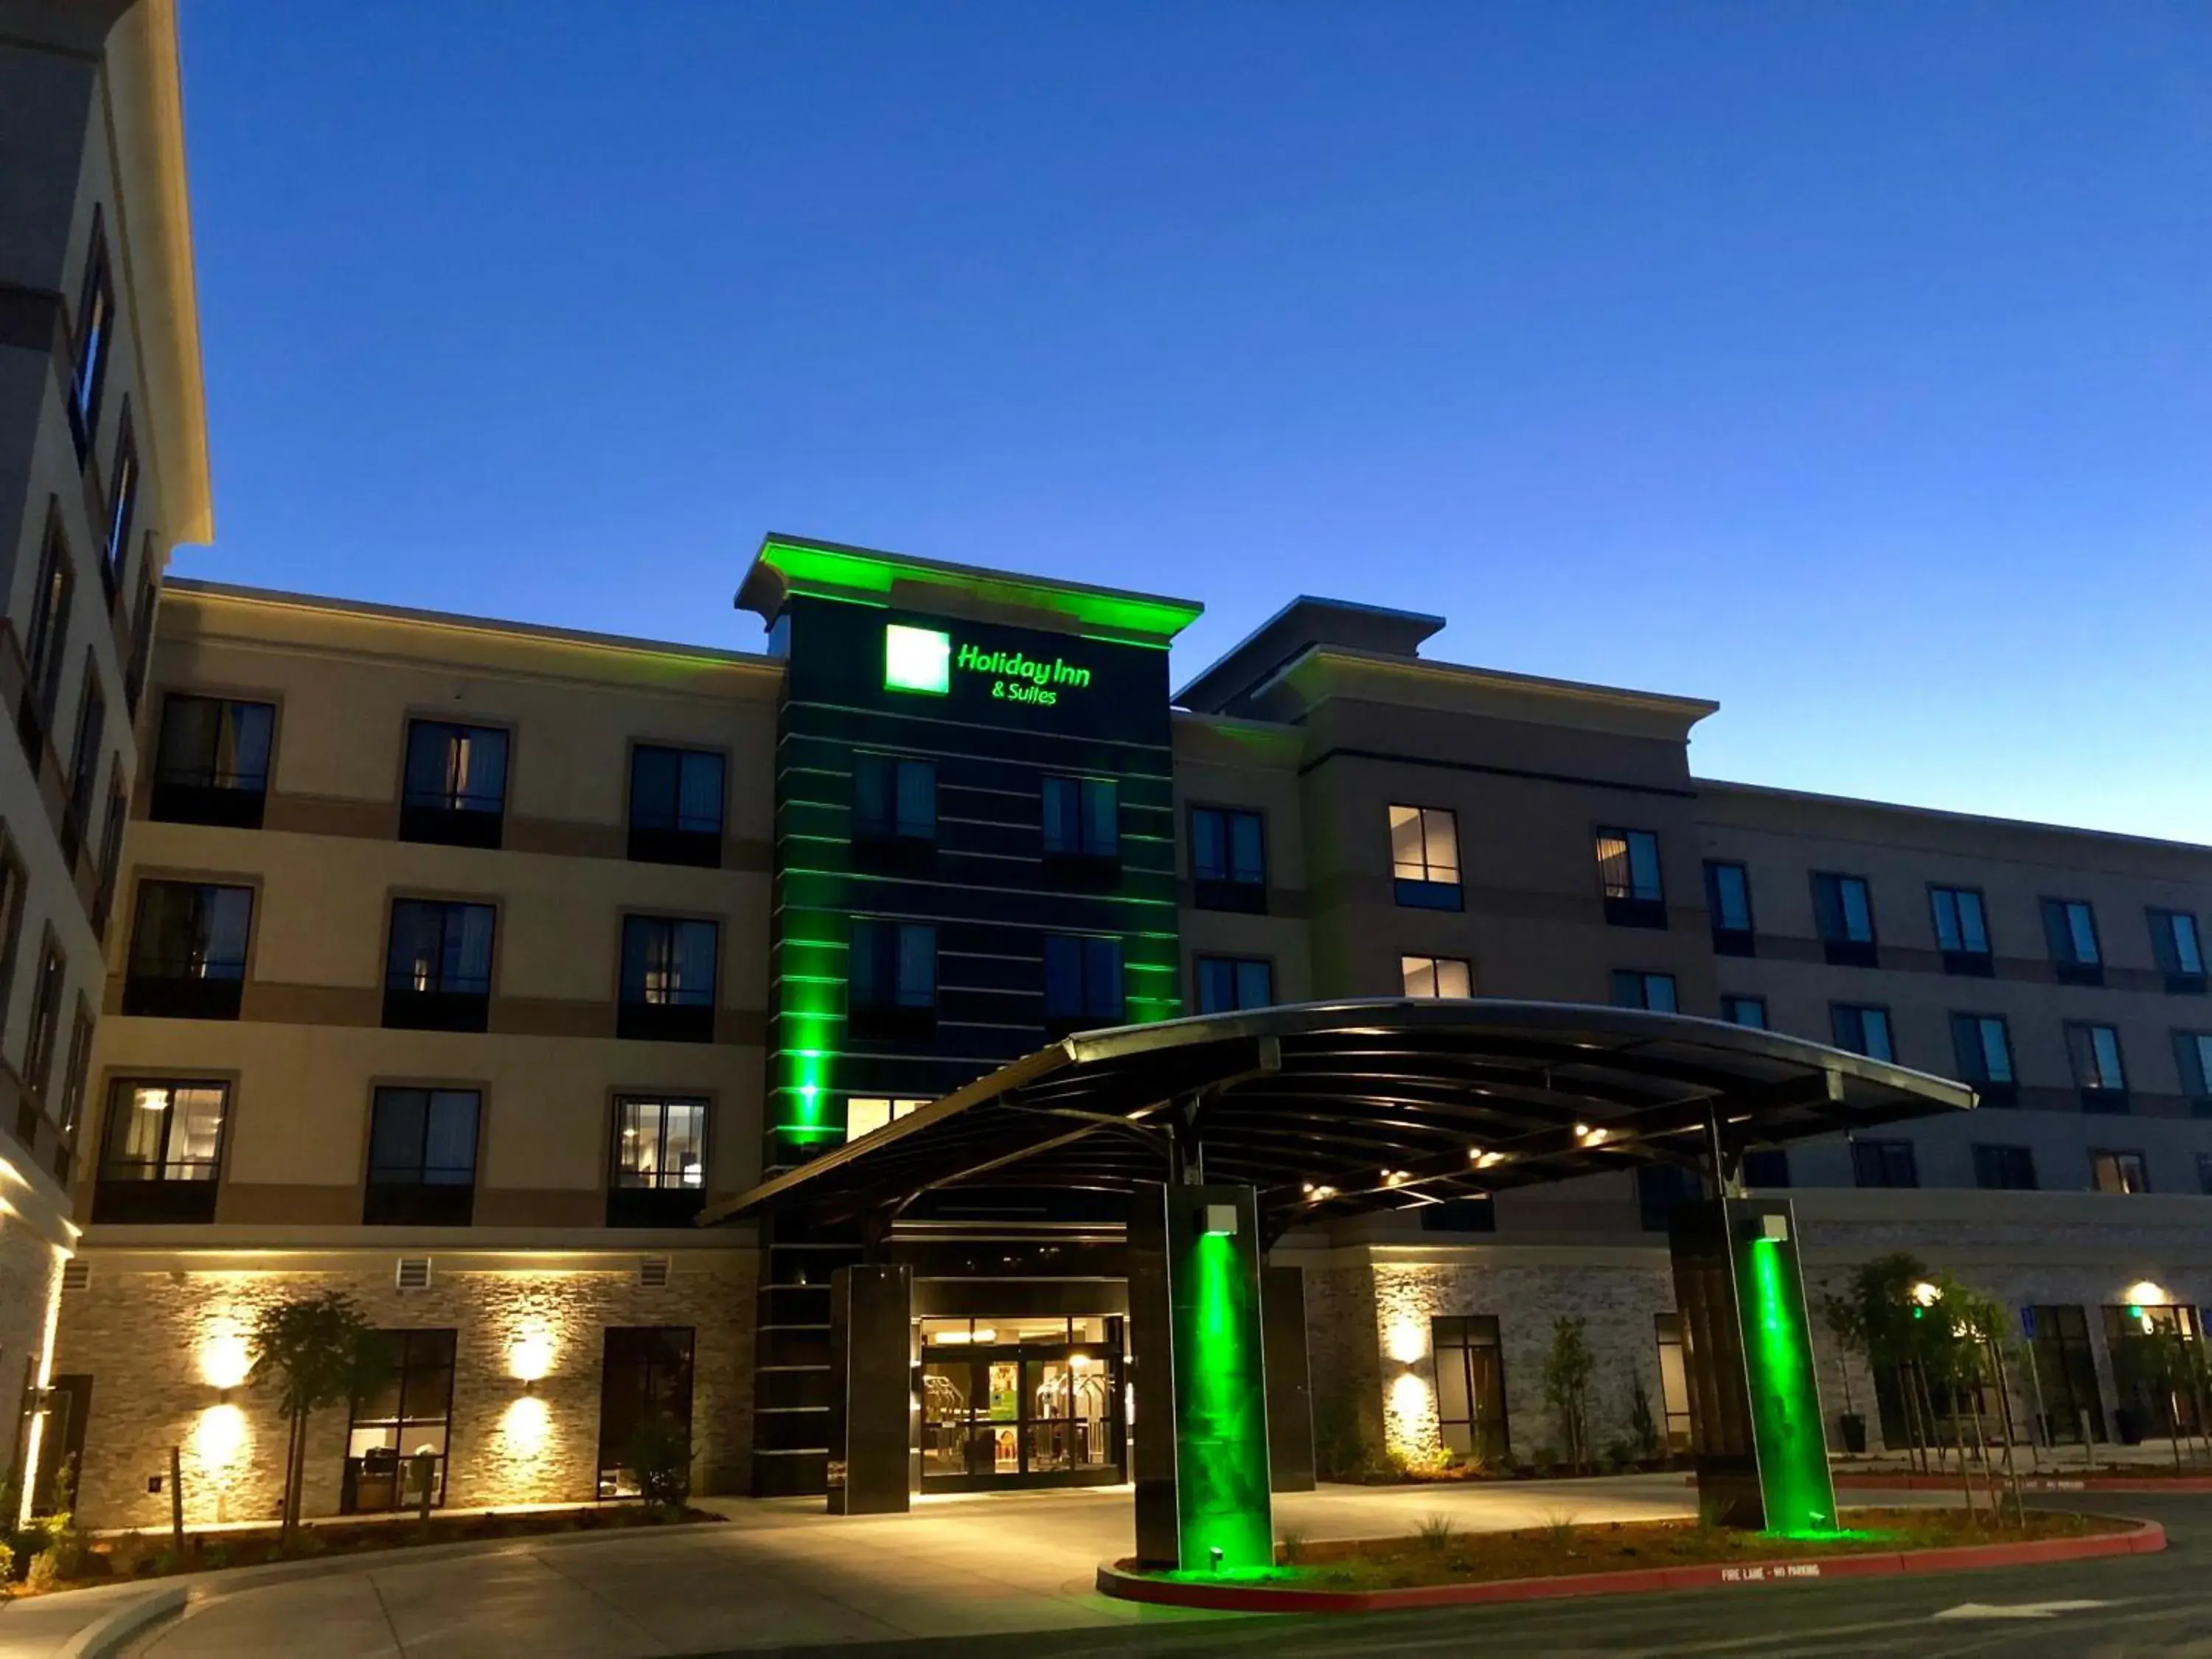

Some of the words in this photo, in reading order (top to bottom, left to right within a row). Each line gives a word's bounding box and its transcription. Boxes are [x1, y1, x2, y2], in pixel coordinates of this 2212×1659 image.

[958, 644, 1051, 685] Holiday
[1054, 658, 1091, 687] Inn
[992, 681, 1004, 698] &
[1007, 683, 1057, 705] Suites
[1722, 1568, 1741, 1581] FIRE
[1742, 1566, 1765, 1581] LANE
[1773, 1565, 1786, 1577] NO
[1787, 1563, 1820, 1577] PARKING
